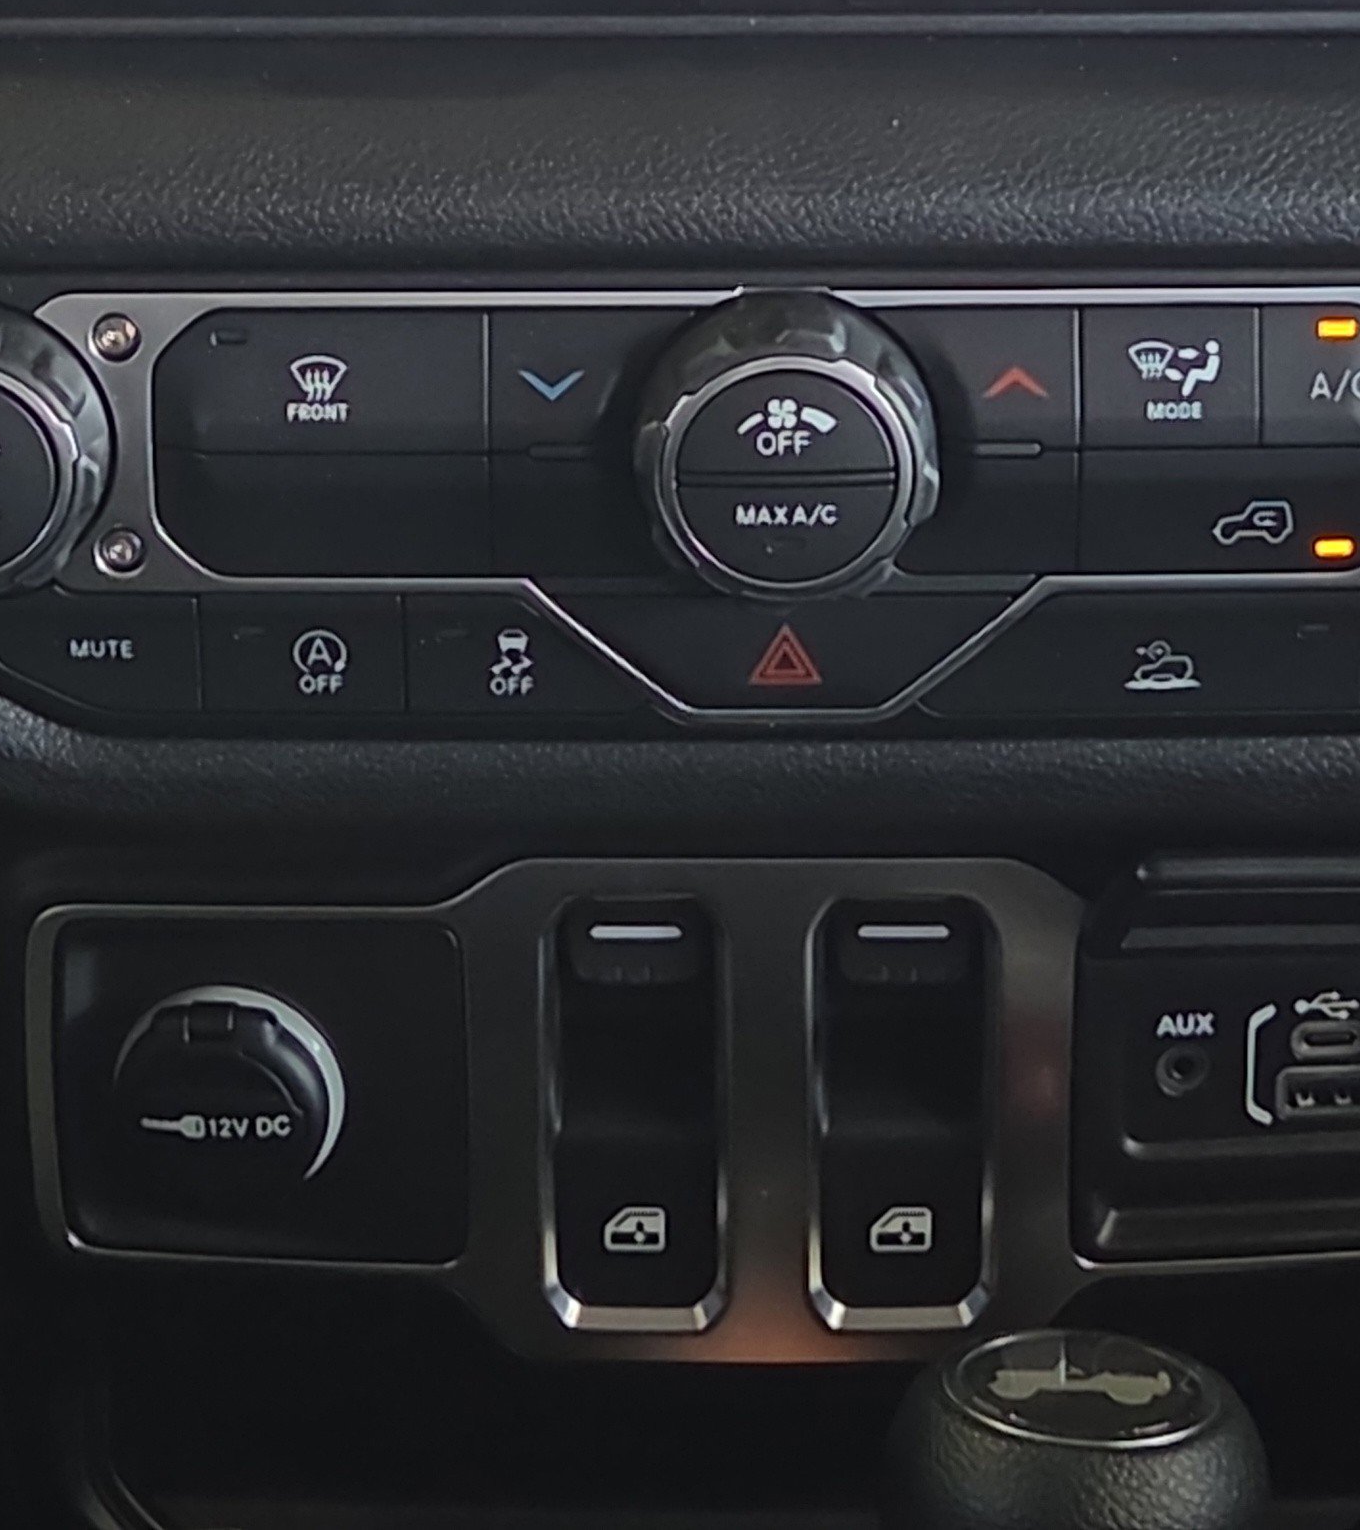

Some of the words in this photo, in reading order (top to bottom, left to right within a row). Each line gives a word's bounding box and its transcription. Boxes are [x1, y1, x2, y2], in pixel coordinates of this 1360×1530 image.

[286, 402, 350, 423] FRONT
[1146, 401, 1202, 421] MODE
[755, 433, 811, 457] OFF
[736, 504, 789, 526] MAX
[791, 504, 838, 526] A/C
[70, 638, 134, 660] MUTE
[299, 675, 343, 695] OFF
[490, 675, 534, 696] OFF
[1156, 1013, 1216, 1038] AUX
[208, 1117, 248, 1139] 12V
[255, 1115, 292, 1138] DC
